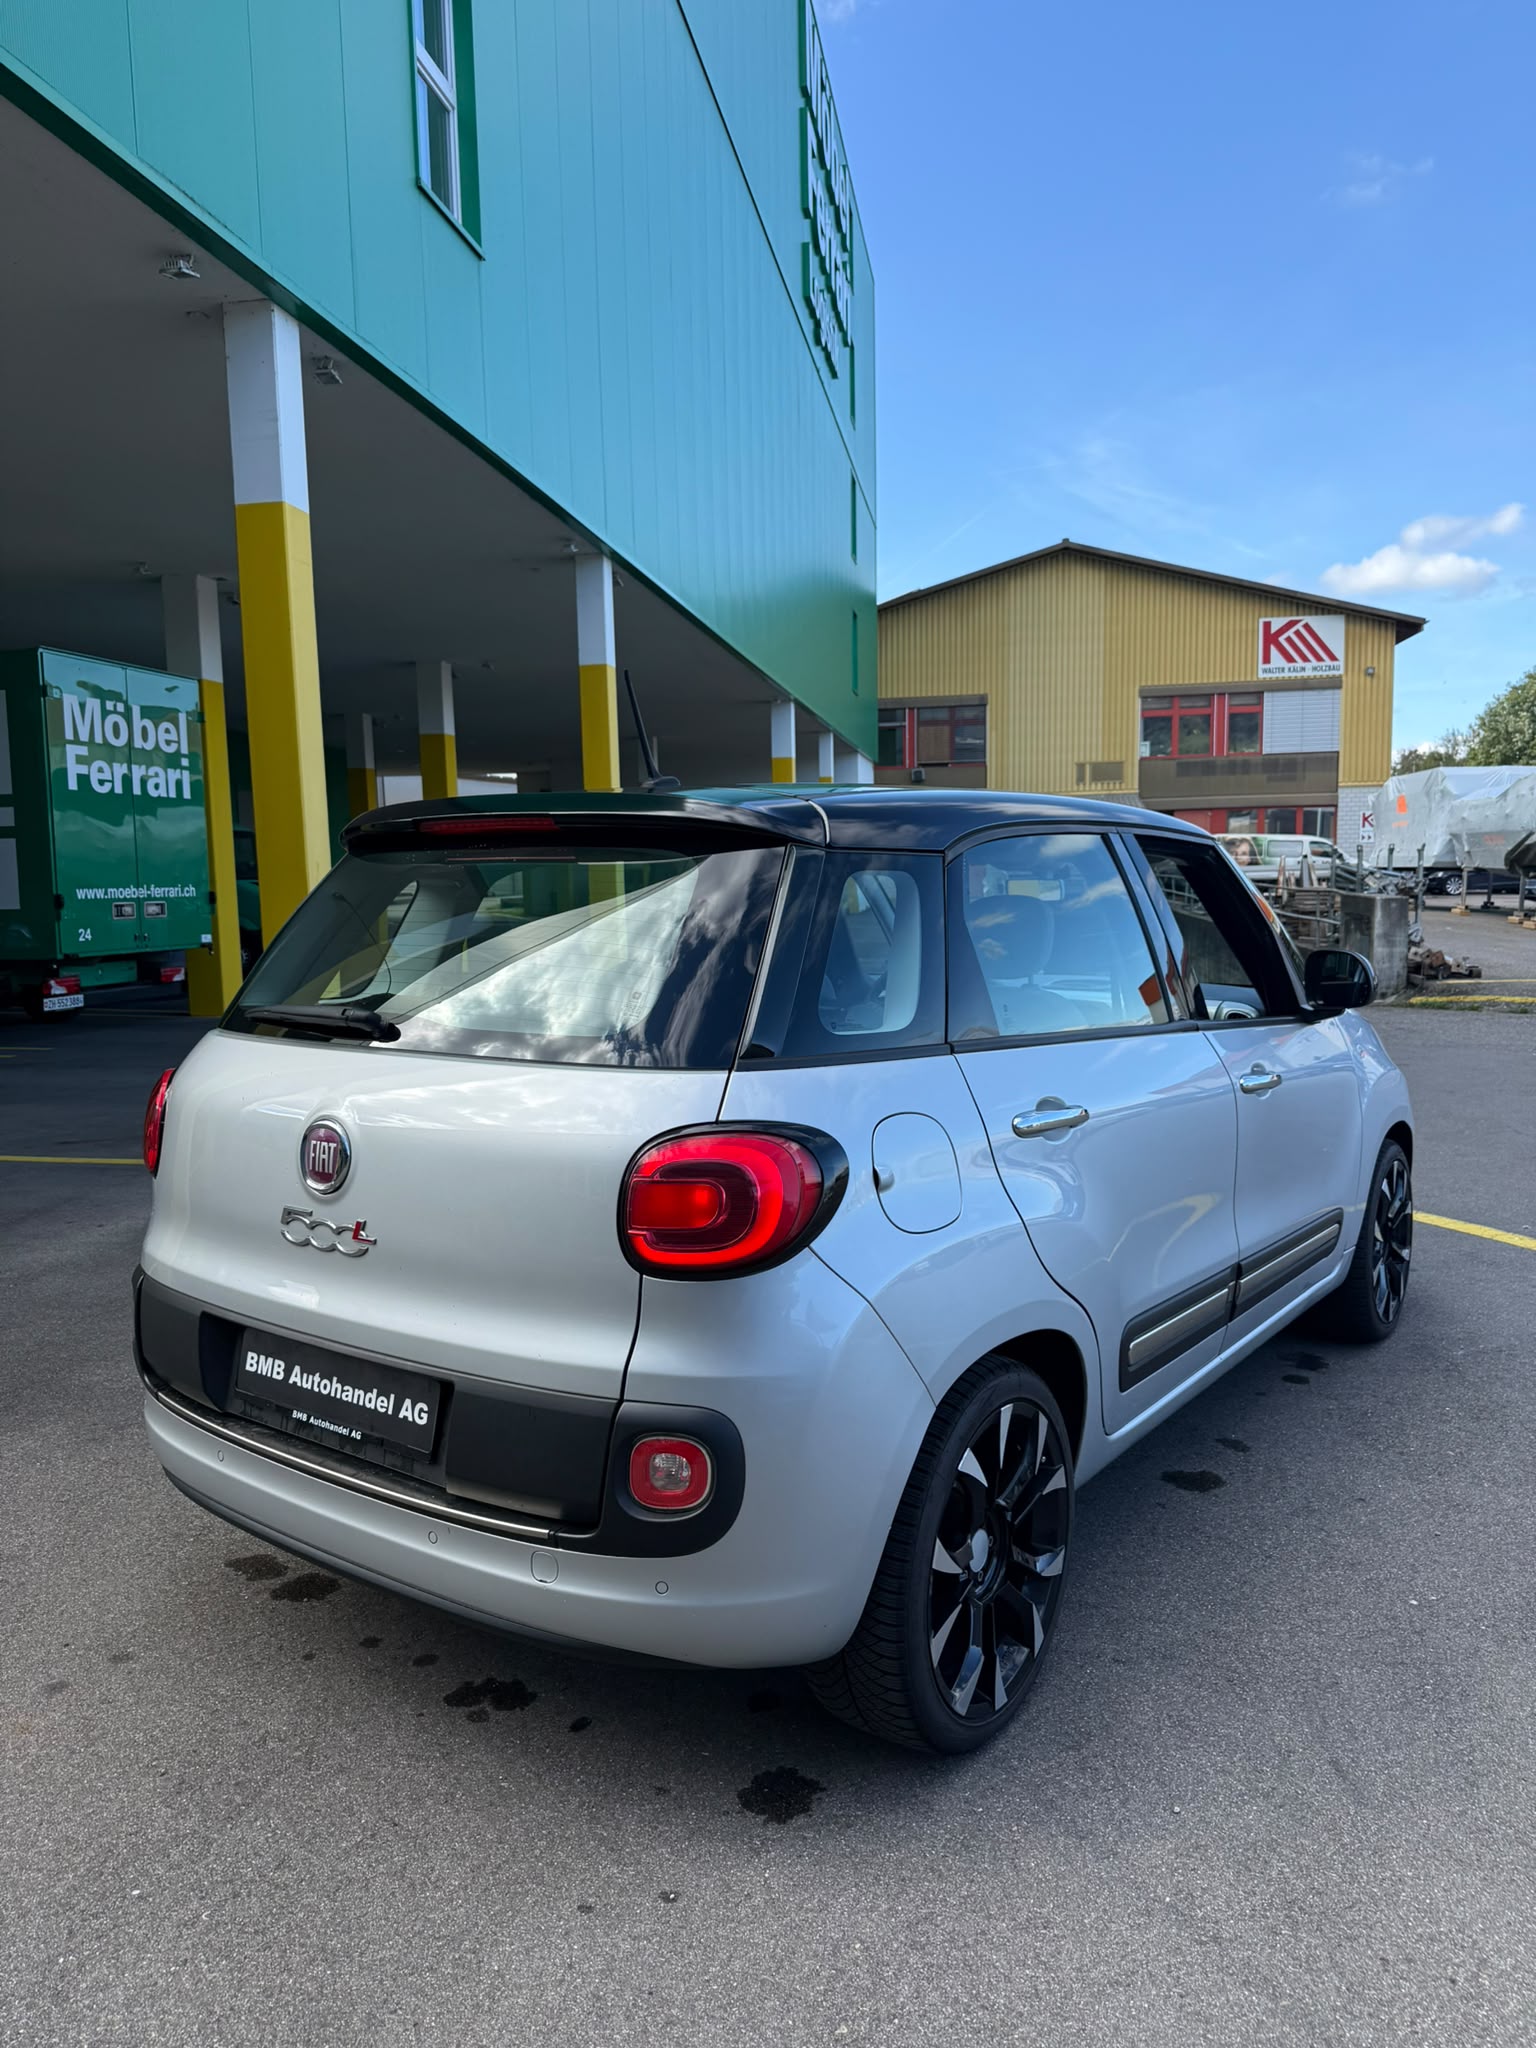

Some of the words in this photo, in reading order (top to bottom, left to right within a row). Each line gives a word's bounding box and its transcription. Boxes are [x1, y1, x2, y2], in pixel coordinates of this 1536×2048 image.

[1261, 666, 1286, 675] WALTER
[1311, 664, 1341, 673] HOLZBAU
[62, 693, 189, 755] Möbel
[65, 743, 191, 800] Ferrari
[76, 884, 196, 900] www.moebel-ferrari.ch
[78, 928, 93, 942] 24
[309, 1140, 337, 1173] FIAT
[245, 1351, 286, 1381] BMB
[288, 1364, 396, 1416] Autohandel
[398, 1398, 430, 1427] AG
[292, 1409, 308, 1422] BMB
[308, 1415, 350, 1437] Autohandel
[350, 1429, 362, 1440] AG
